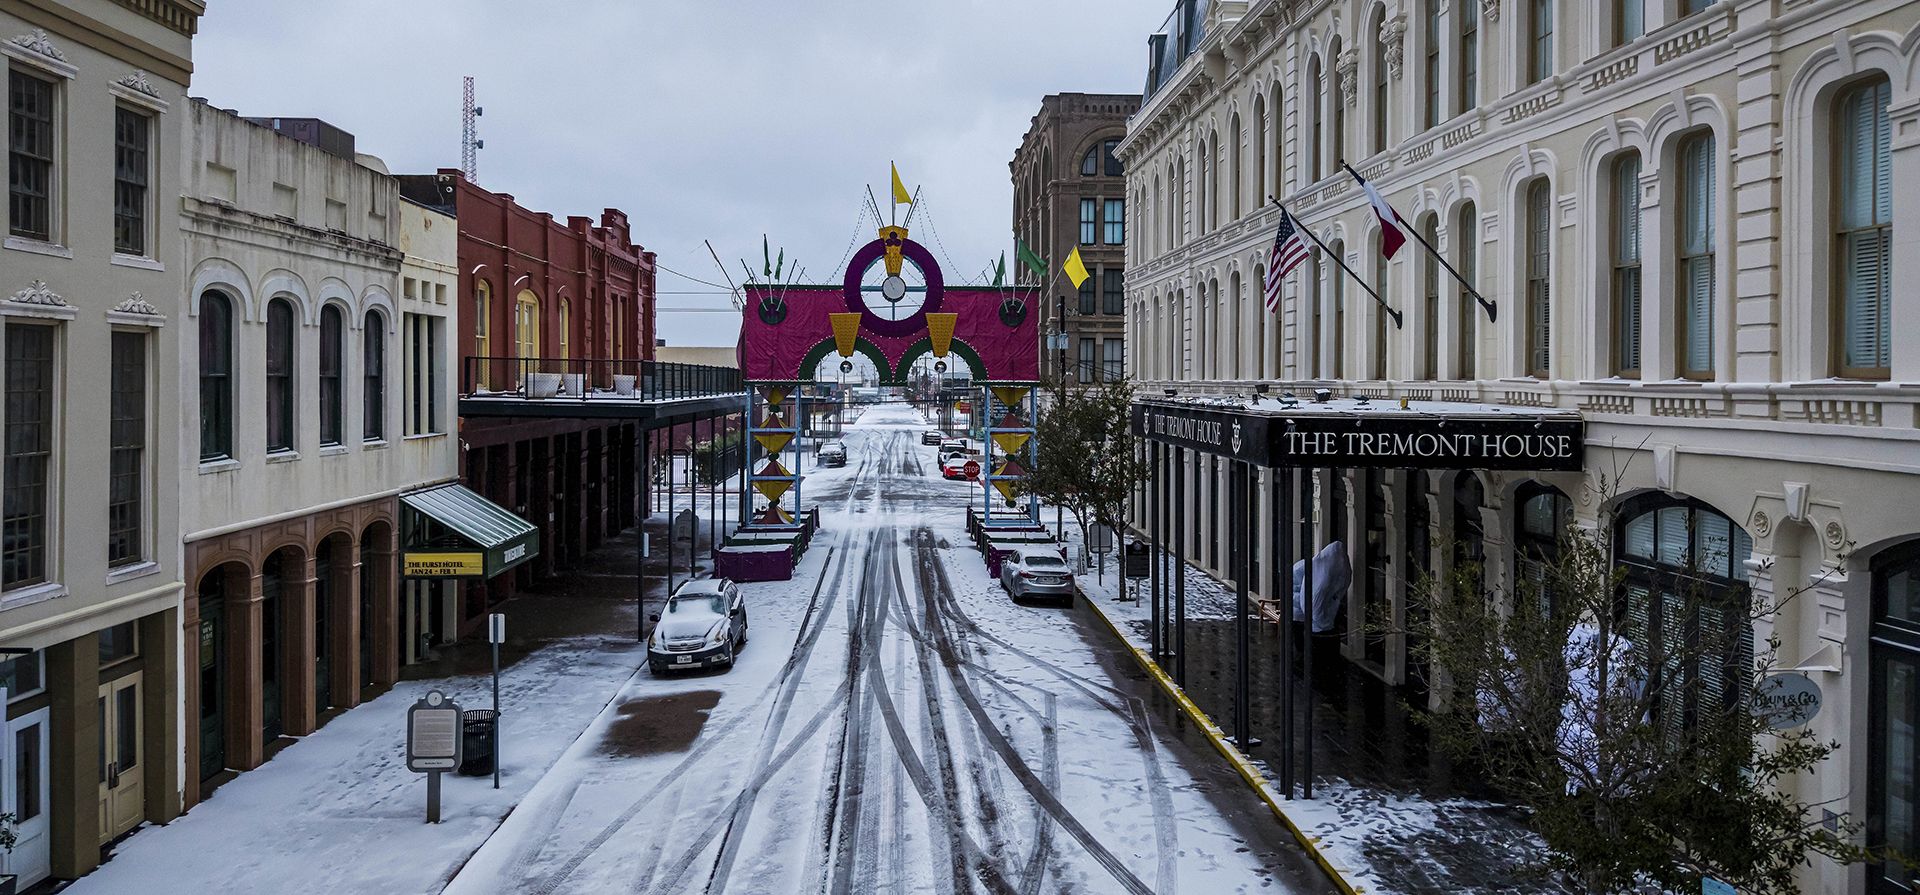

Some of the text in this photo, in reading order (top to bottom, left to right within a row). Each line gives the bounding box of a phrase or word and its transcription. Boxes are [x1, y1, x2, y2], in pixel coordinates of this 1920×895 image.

[1154, 414, 1222, 446] THE TREMONT HOUSE
[1283, 431, 1573, 458] THE TREMONT HOUSE
[964, 465, 980, 474] STOP
